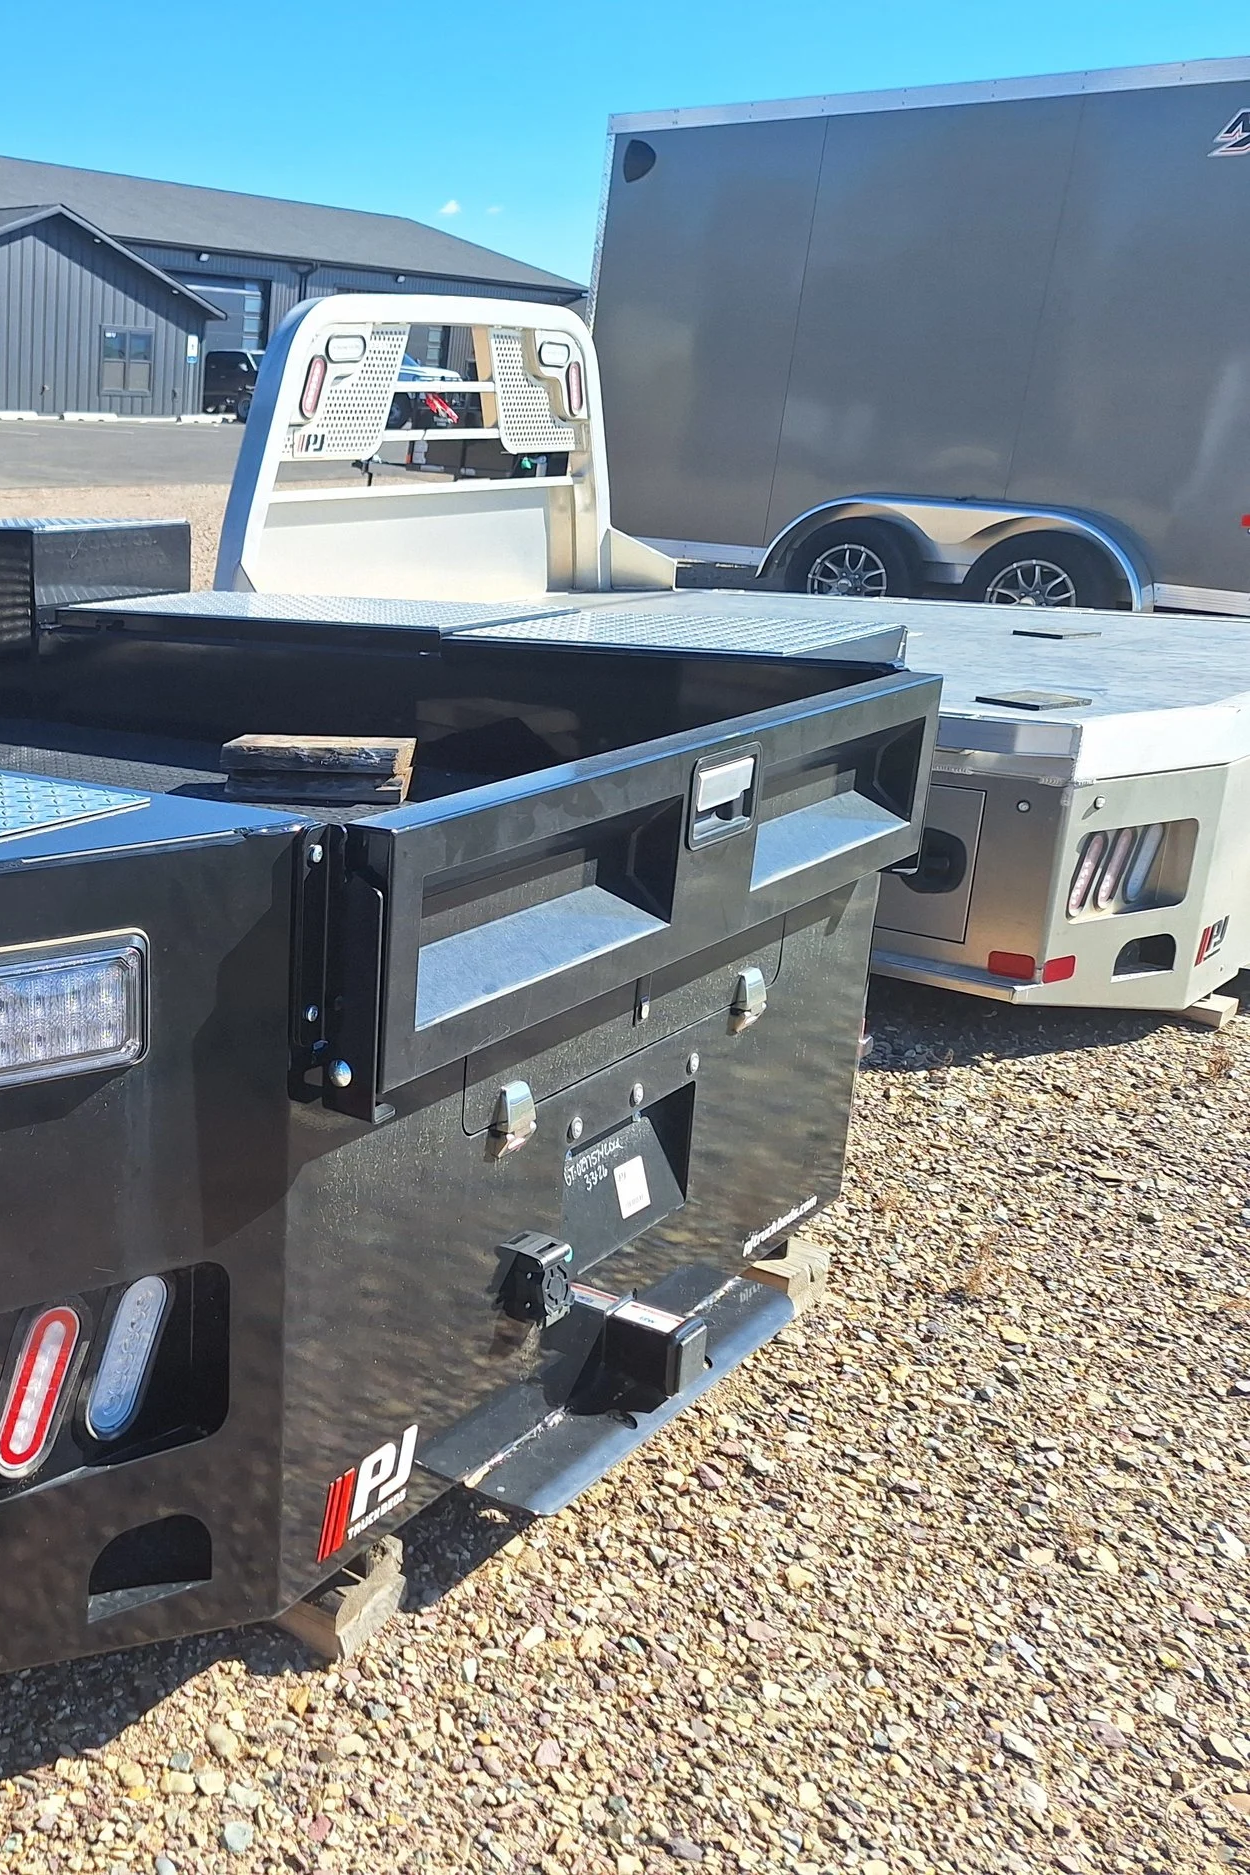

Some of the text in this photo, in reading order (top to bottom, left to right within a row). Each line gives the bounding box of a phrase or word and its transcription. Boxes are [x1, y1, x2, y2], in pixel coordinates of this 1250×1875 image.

[304, 433, 326, 453] PJ
[1205, 914, 1230, 953] PJ
[742, 1194, 818, 1258] pjtruckbeds.com
[350, 1424, 419, 1523] PJ
